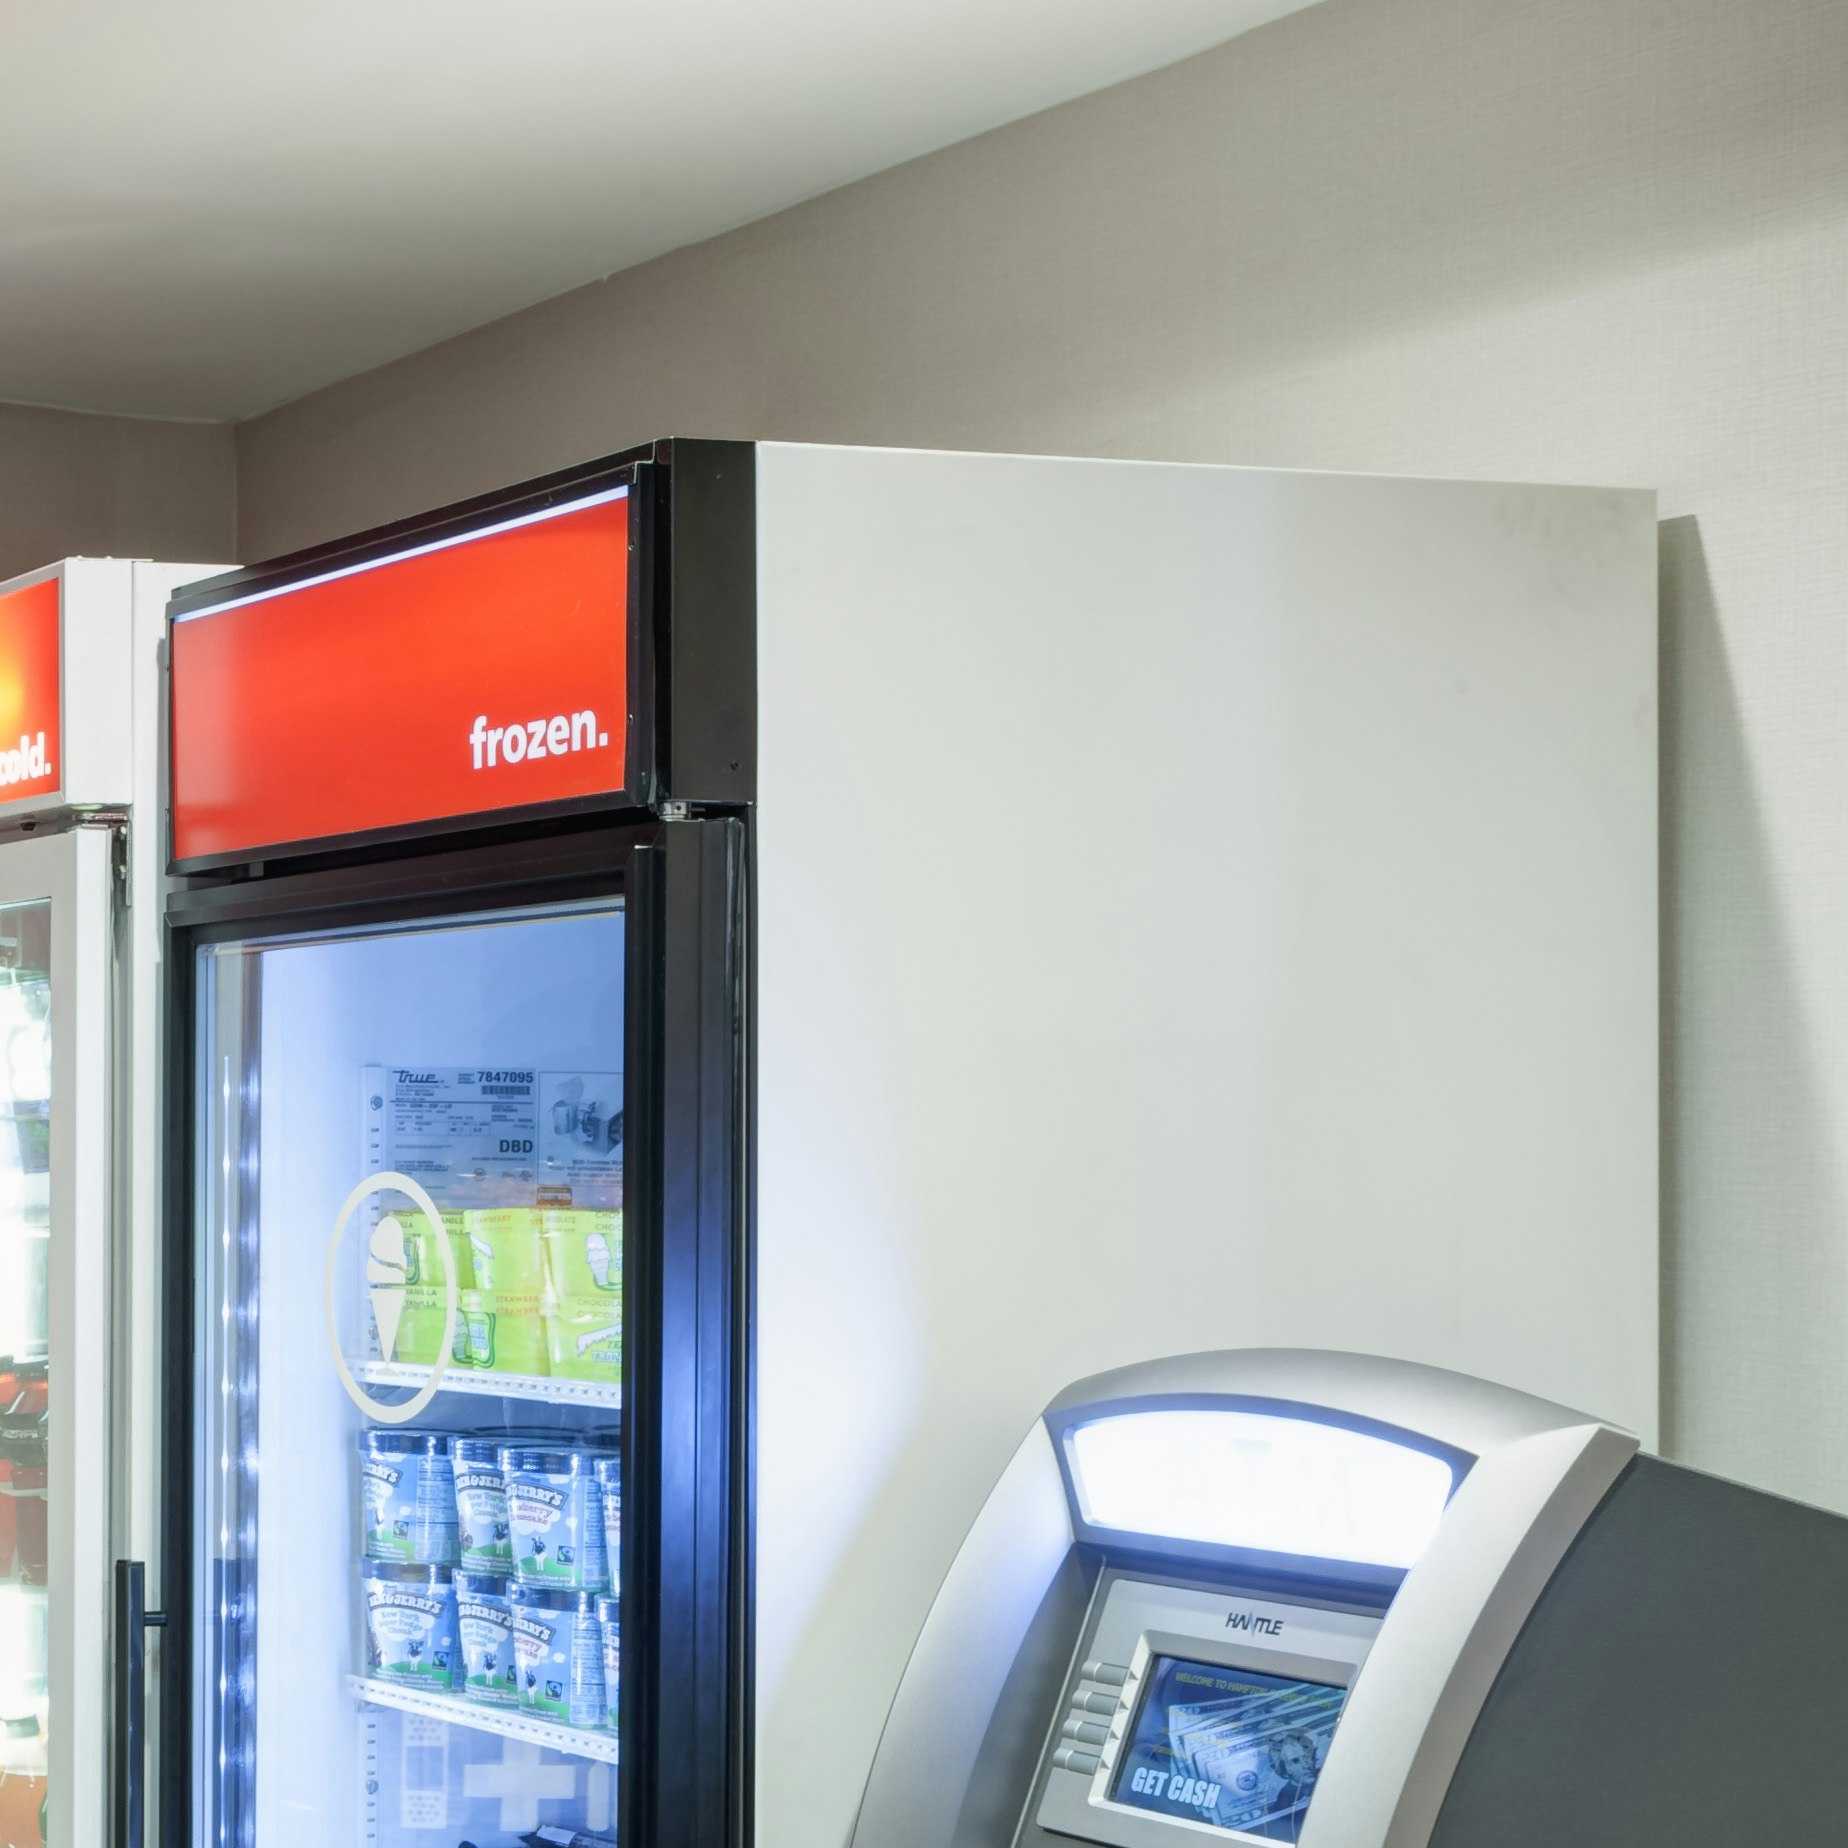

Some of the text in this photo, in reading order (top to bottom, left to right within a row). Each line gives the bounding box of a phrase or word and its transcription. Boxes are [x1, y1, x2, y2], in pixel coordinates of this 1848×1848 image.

[469, 708, 609, 772] frozen.
[393, 1069, 534, 1084] true 7847095
[499, 1139, 533, 1154] DBD
[1175, 1672, 1228, 1690] WELCOME TO
[1131, 1768, 1222, 1810] GET CASH
